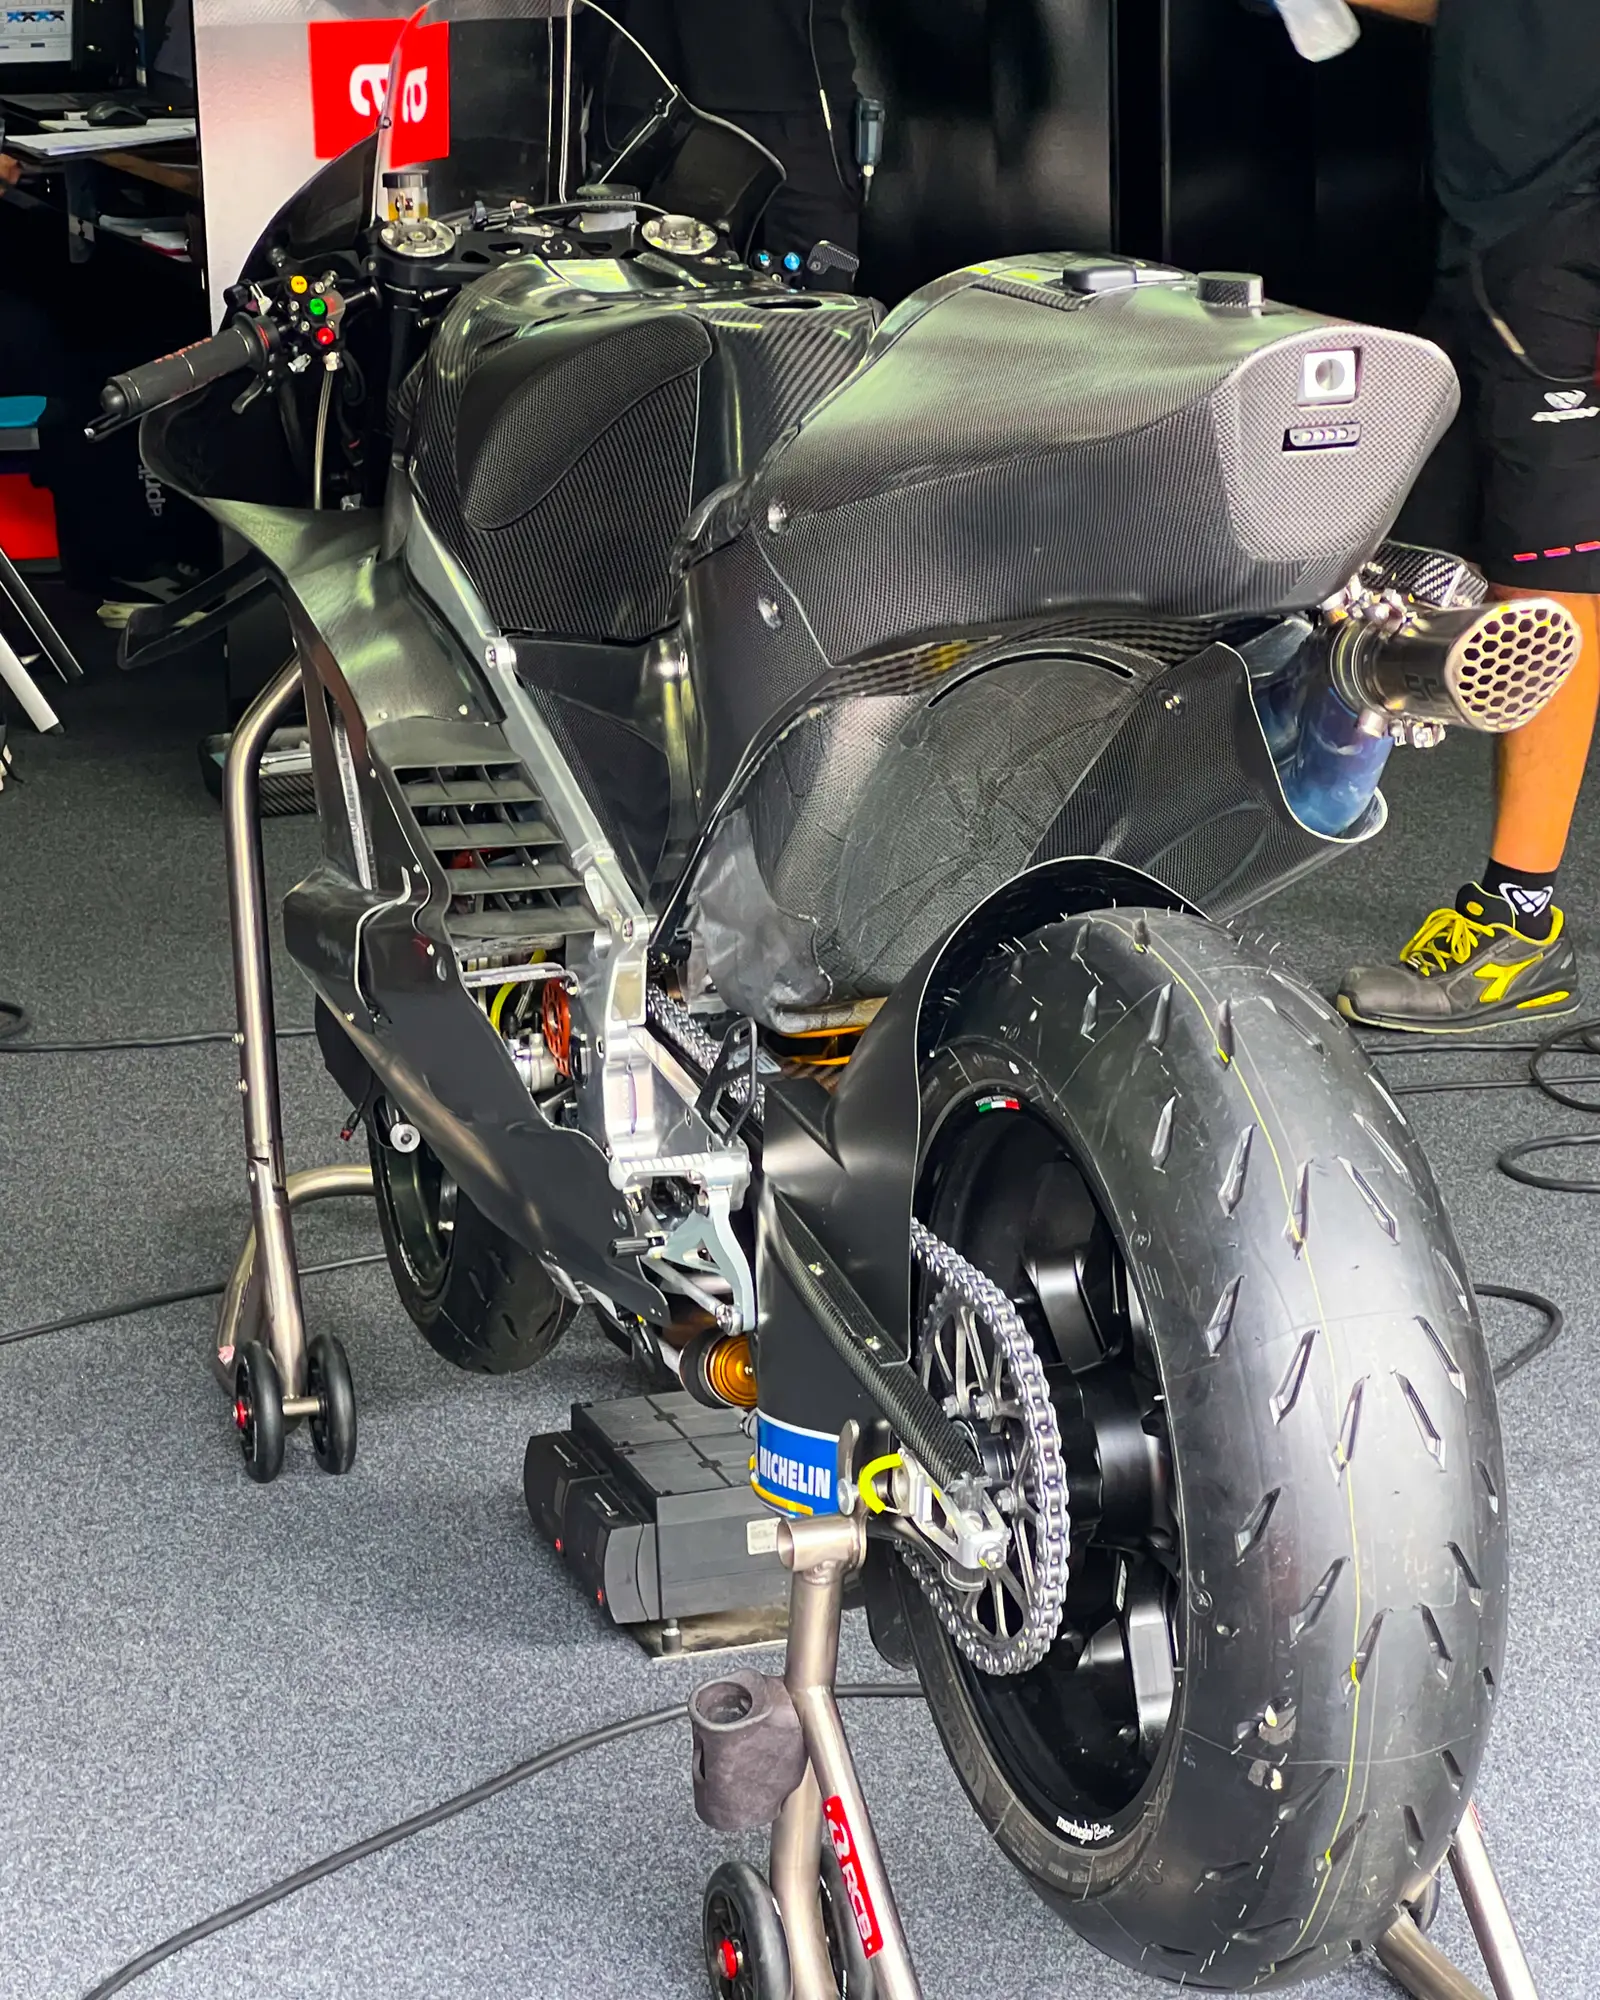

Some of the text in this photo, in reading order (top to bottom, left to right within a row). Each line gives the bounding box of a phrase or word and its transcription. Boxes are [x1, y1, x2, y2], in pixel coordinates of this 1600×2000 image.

[138, 463, 166, 517] april
[759, 1445, 831, 1500] MICHELIN
[842, 1861, 873, 1941] RCB
